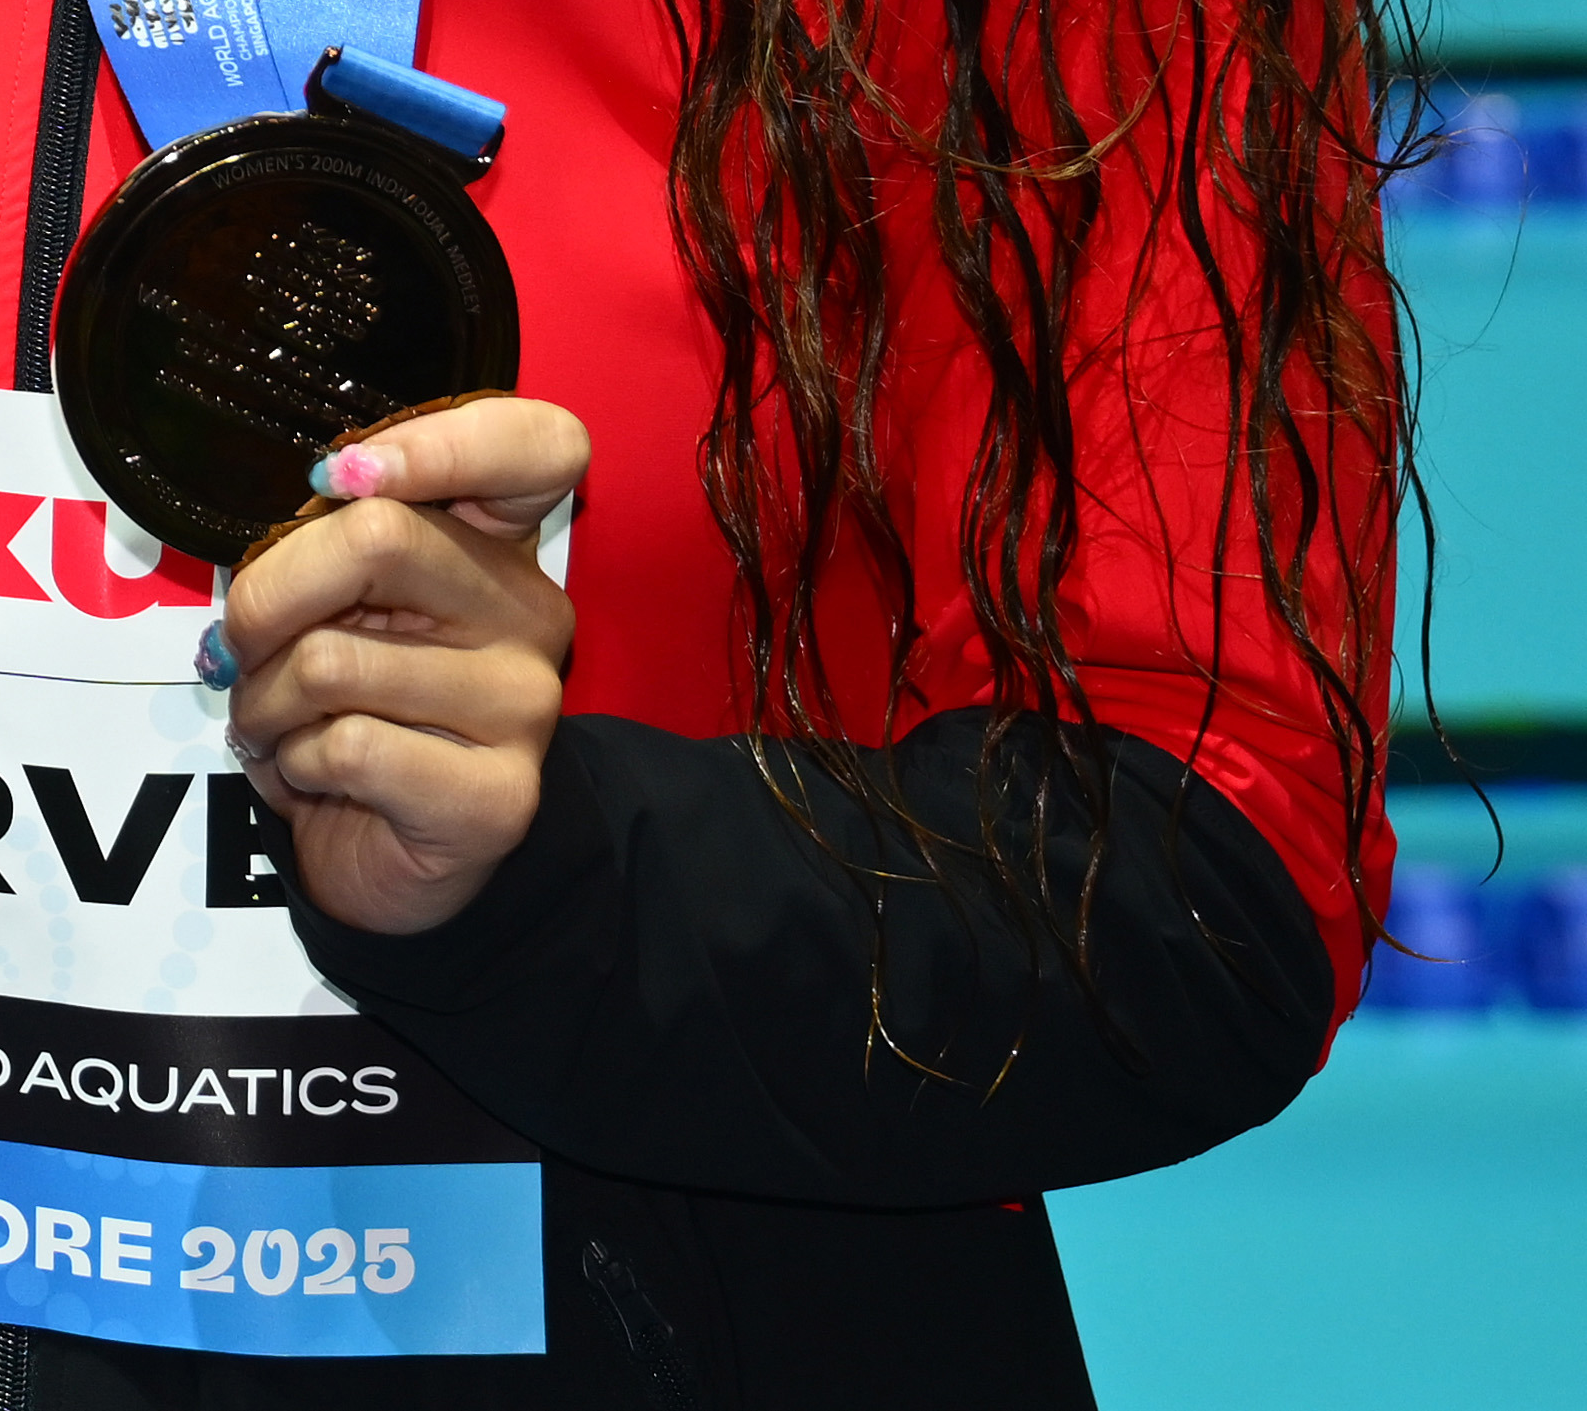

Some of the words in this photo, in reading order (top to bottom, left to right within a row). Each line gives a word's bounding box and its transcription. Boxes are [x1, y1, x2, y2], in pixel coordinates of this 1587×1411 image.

[208, 24, 244, 87] WORLD
[211, 154, 306, 190] WOMEN'S
[311, 154, 364, 179] 200M
[365, 167, 452, 246] INDIVIDUAL
[446, 244, 483, 316] MEDLEY
[19, 1051, 399, 1116] AQUATICS
[179, 1226, 415, 1296] 2025
